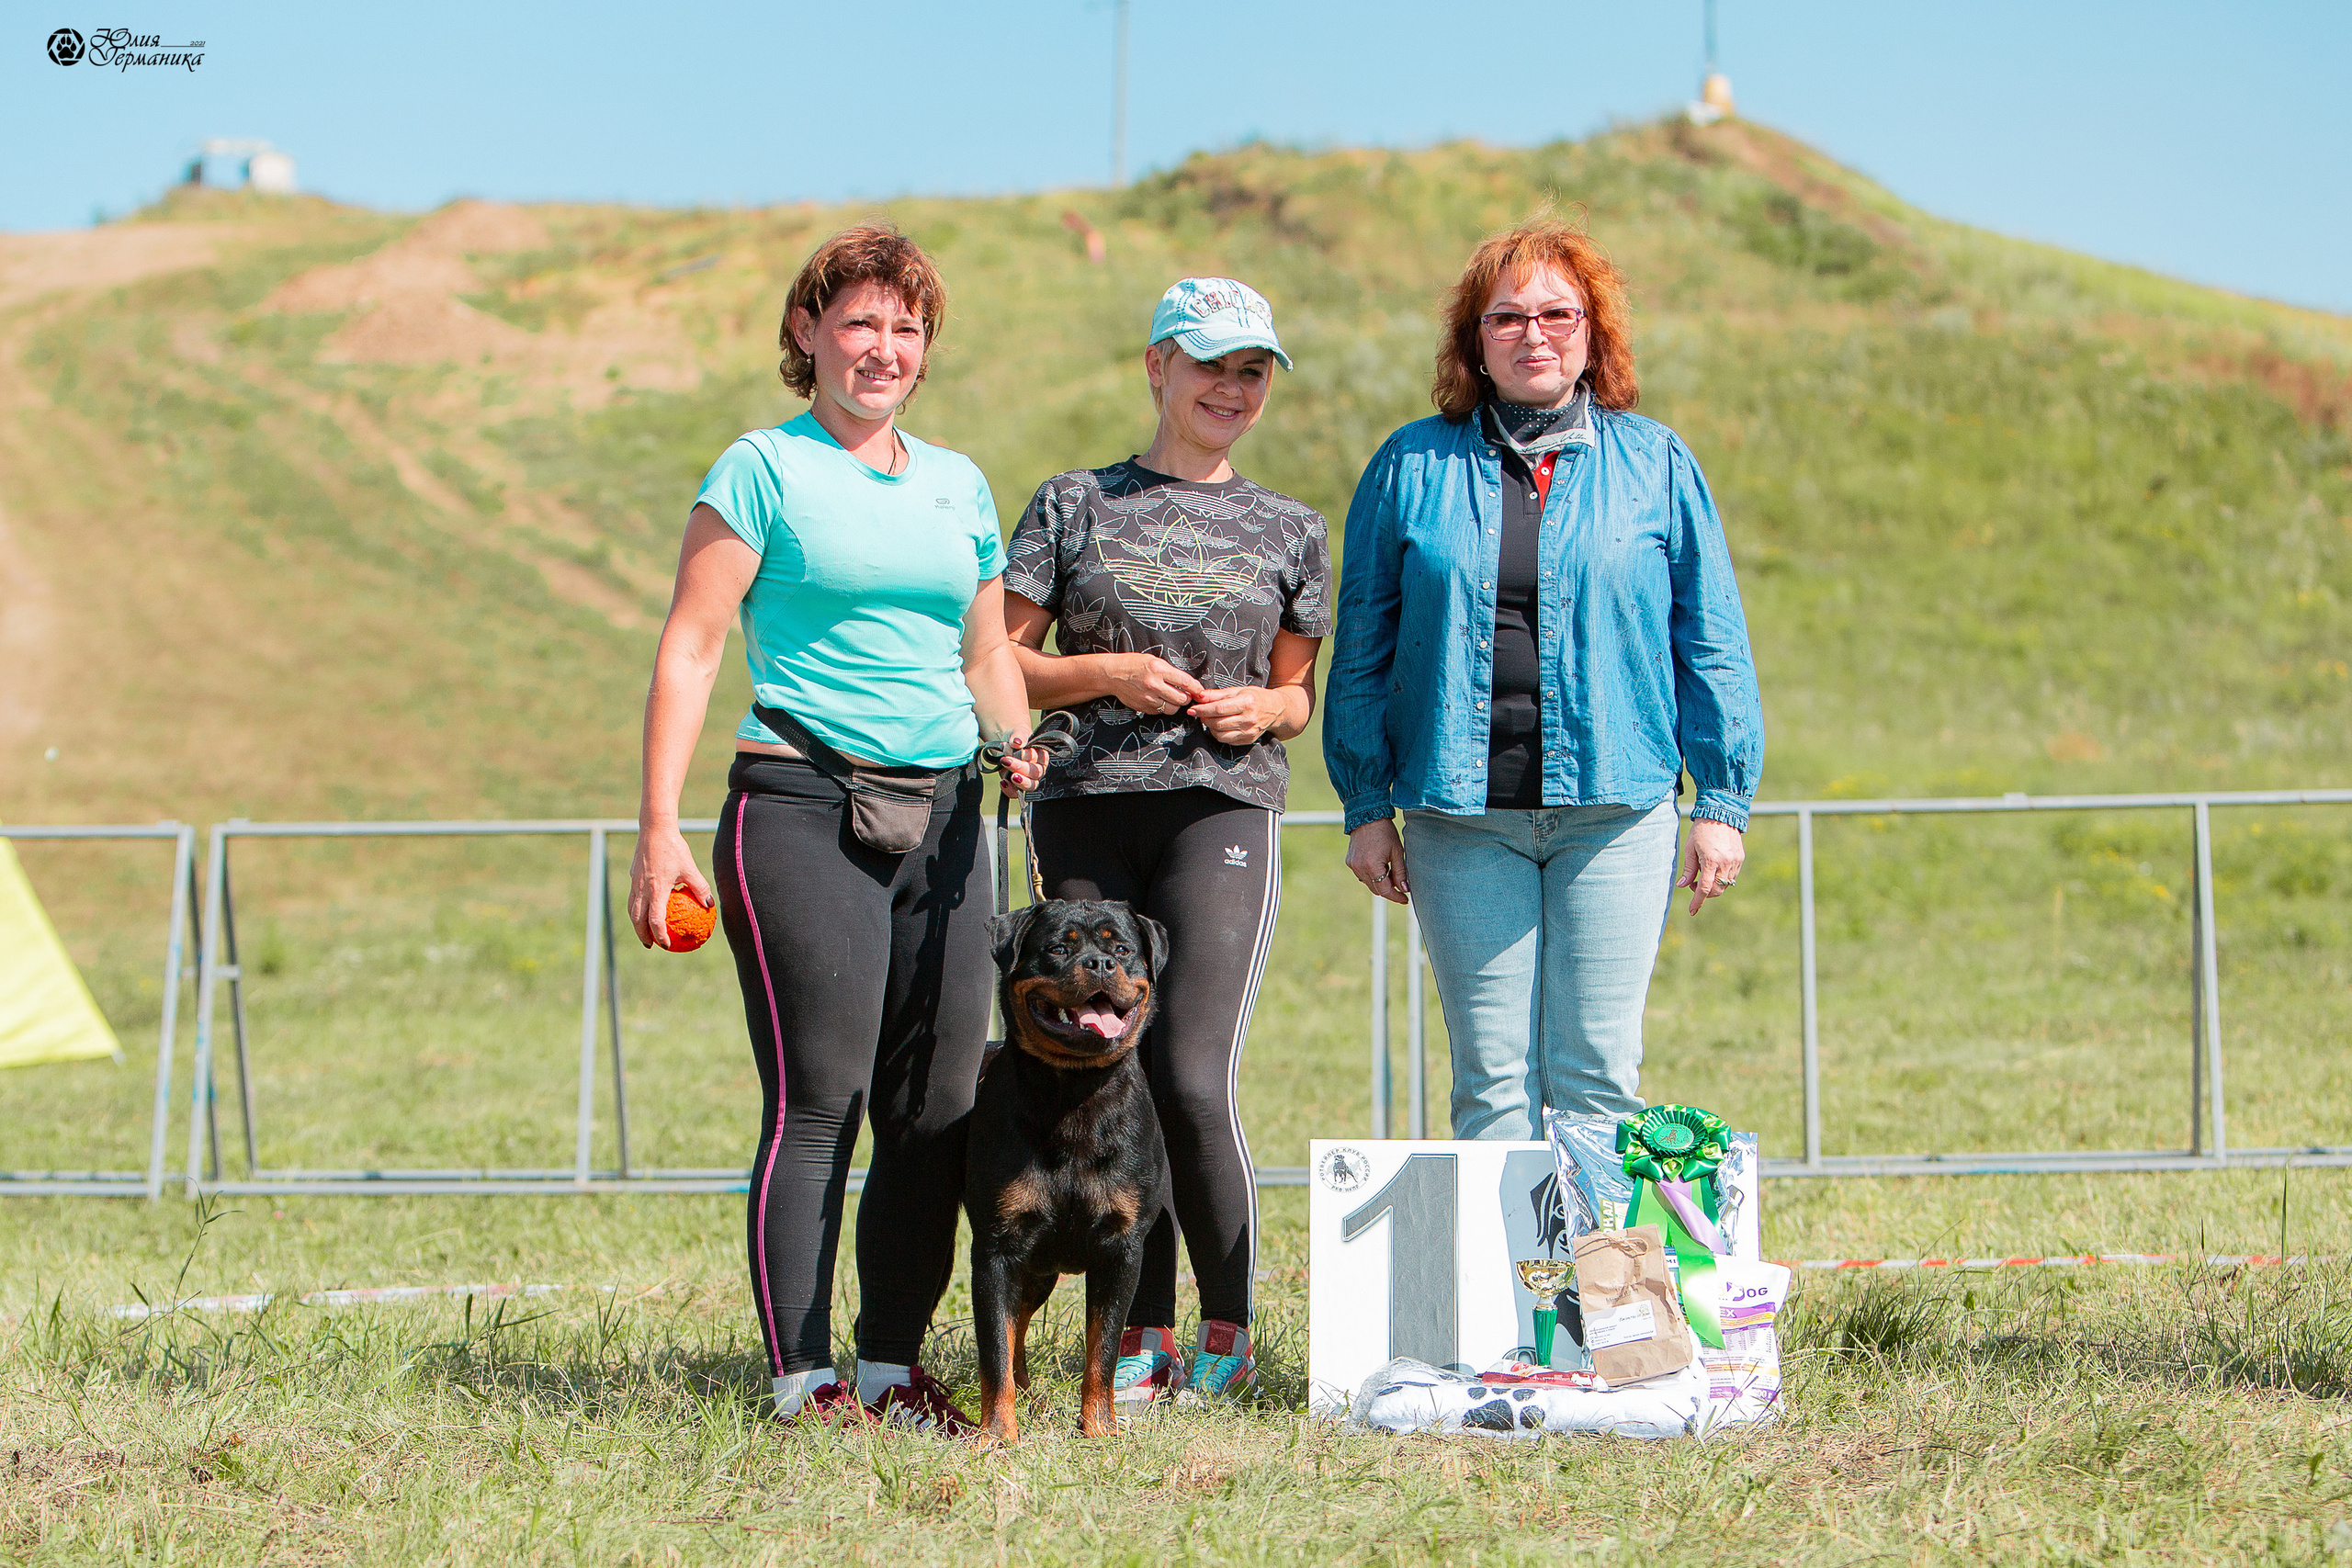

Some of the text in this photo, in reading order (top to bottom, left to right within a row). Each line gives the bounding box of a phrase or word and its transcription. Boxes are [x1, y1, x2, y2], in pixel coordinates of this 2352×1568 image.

[1224, 858, 1248, 868] adidas
[1342, 1153, 1459, 1372] 1
[1210, 1323, 1235, 1333] Reebok
